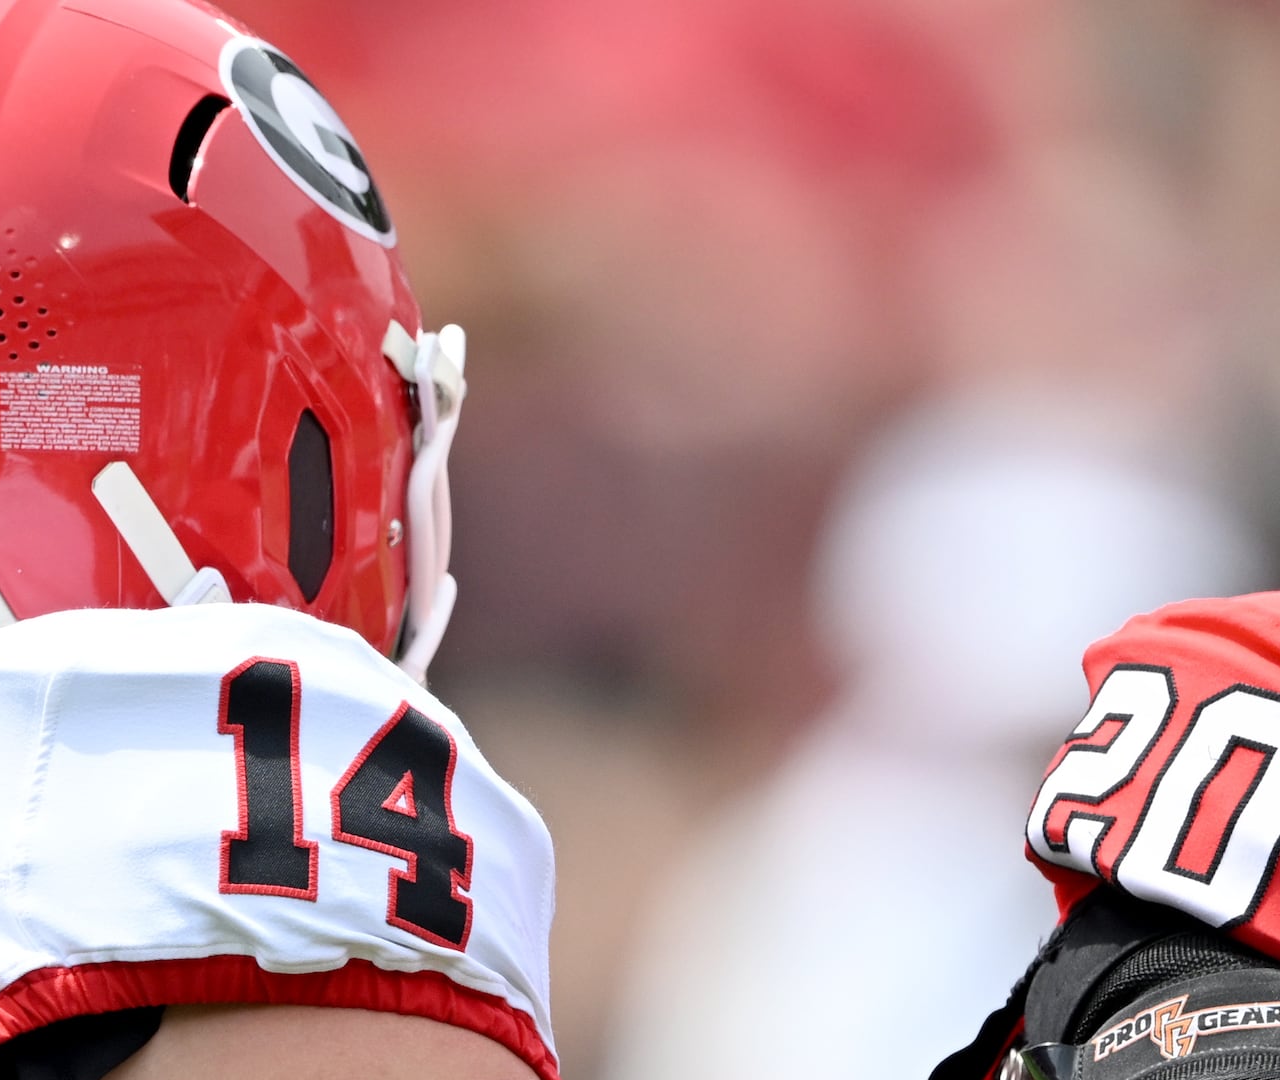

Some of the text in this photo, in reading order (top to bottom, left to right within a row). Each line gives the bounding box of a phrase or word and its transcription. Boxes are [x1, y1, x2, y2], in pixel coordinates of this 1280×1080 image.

[36, 364, 109, 375] WARNING
[217, 655, 474, 953] 14
[1098, 1012, 1153, 1056] PRO
